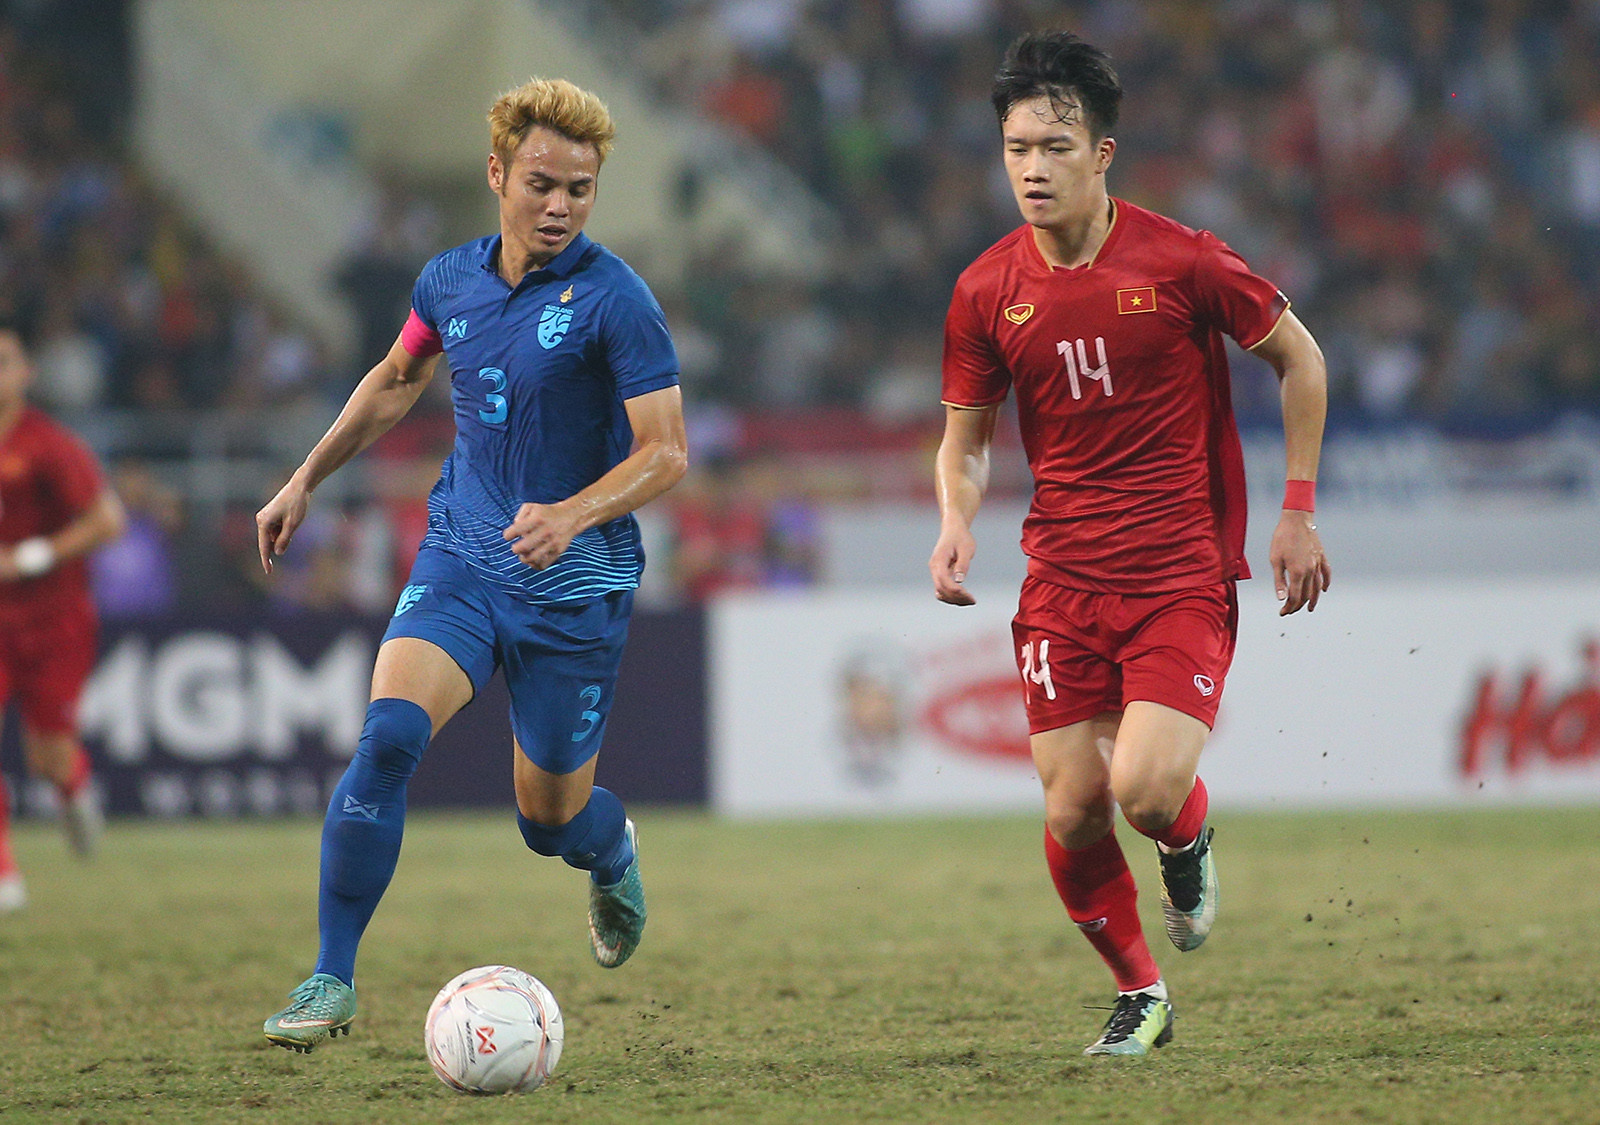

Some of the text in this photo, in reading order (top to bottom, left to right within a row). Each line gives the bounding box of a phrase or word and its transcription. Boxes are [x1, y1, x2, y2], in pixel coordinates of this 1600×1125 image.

[545, 304, 574, 315] THAILAND
[478, 367, 508, 424] 3
[1056, 337, 1113, 400] 14
[1021, 639, 1056, 704] 14
[571, 684, 602, 743] 3
